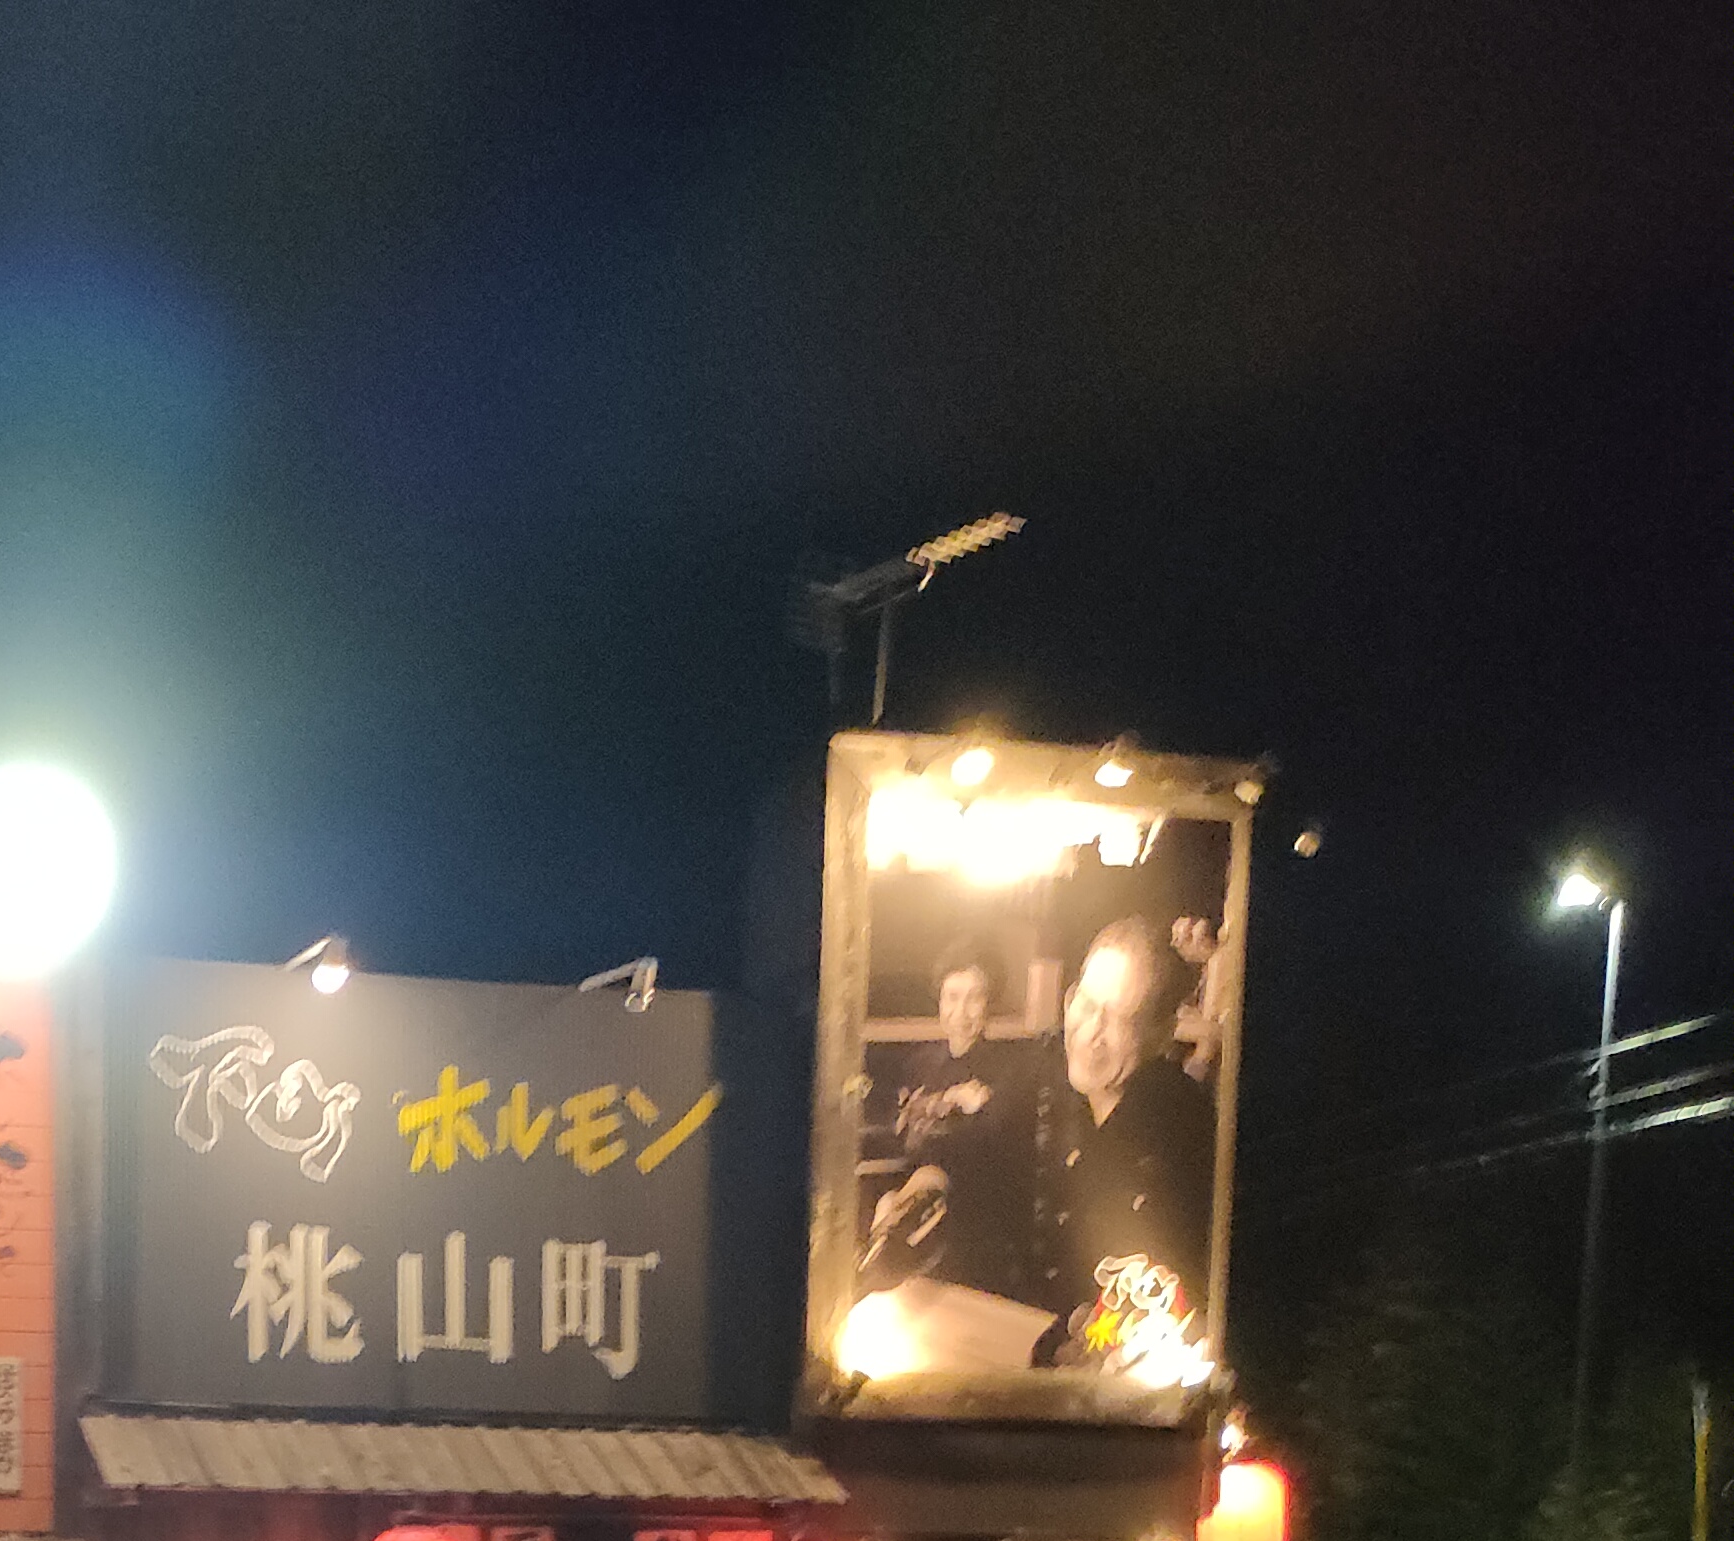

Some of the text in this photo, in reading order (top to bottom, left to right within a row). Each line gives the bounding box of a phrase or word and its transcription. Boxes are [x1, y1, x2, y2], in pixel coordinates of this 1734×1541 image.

[391, 1064, 723, 1175] ホルモン
[230, 1220, 660, 1380] 桃山町
